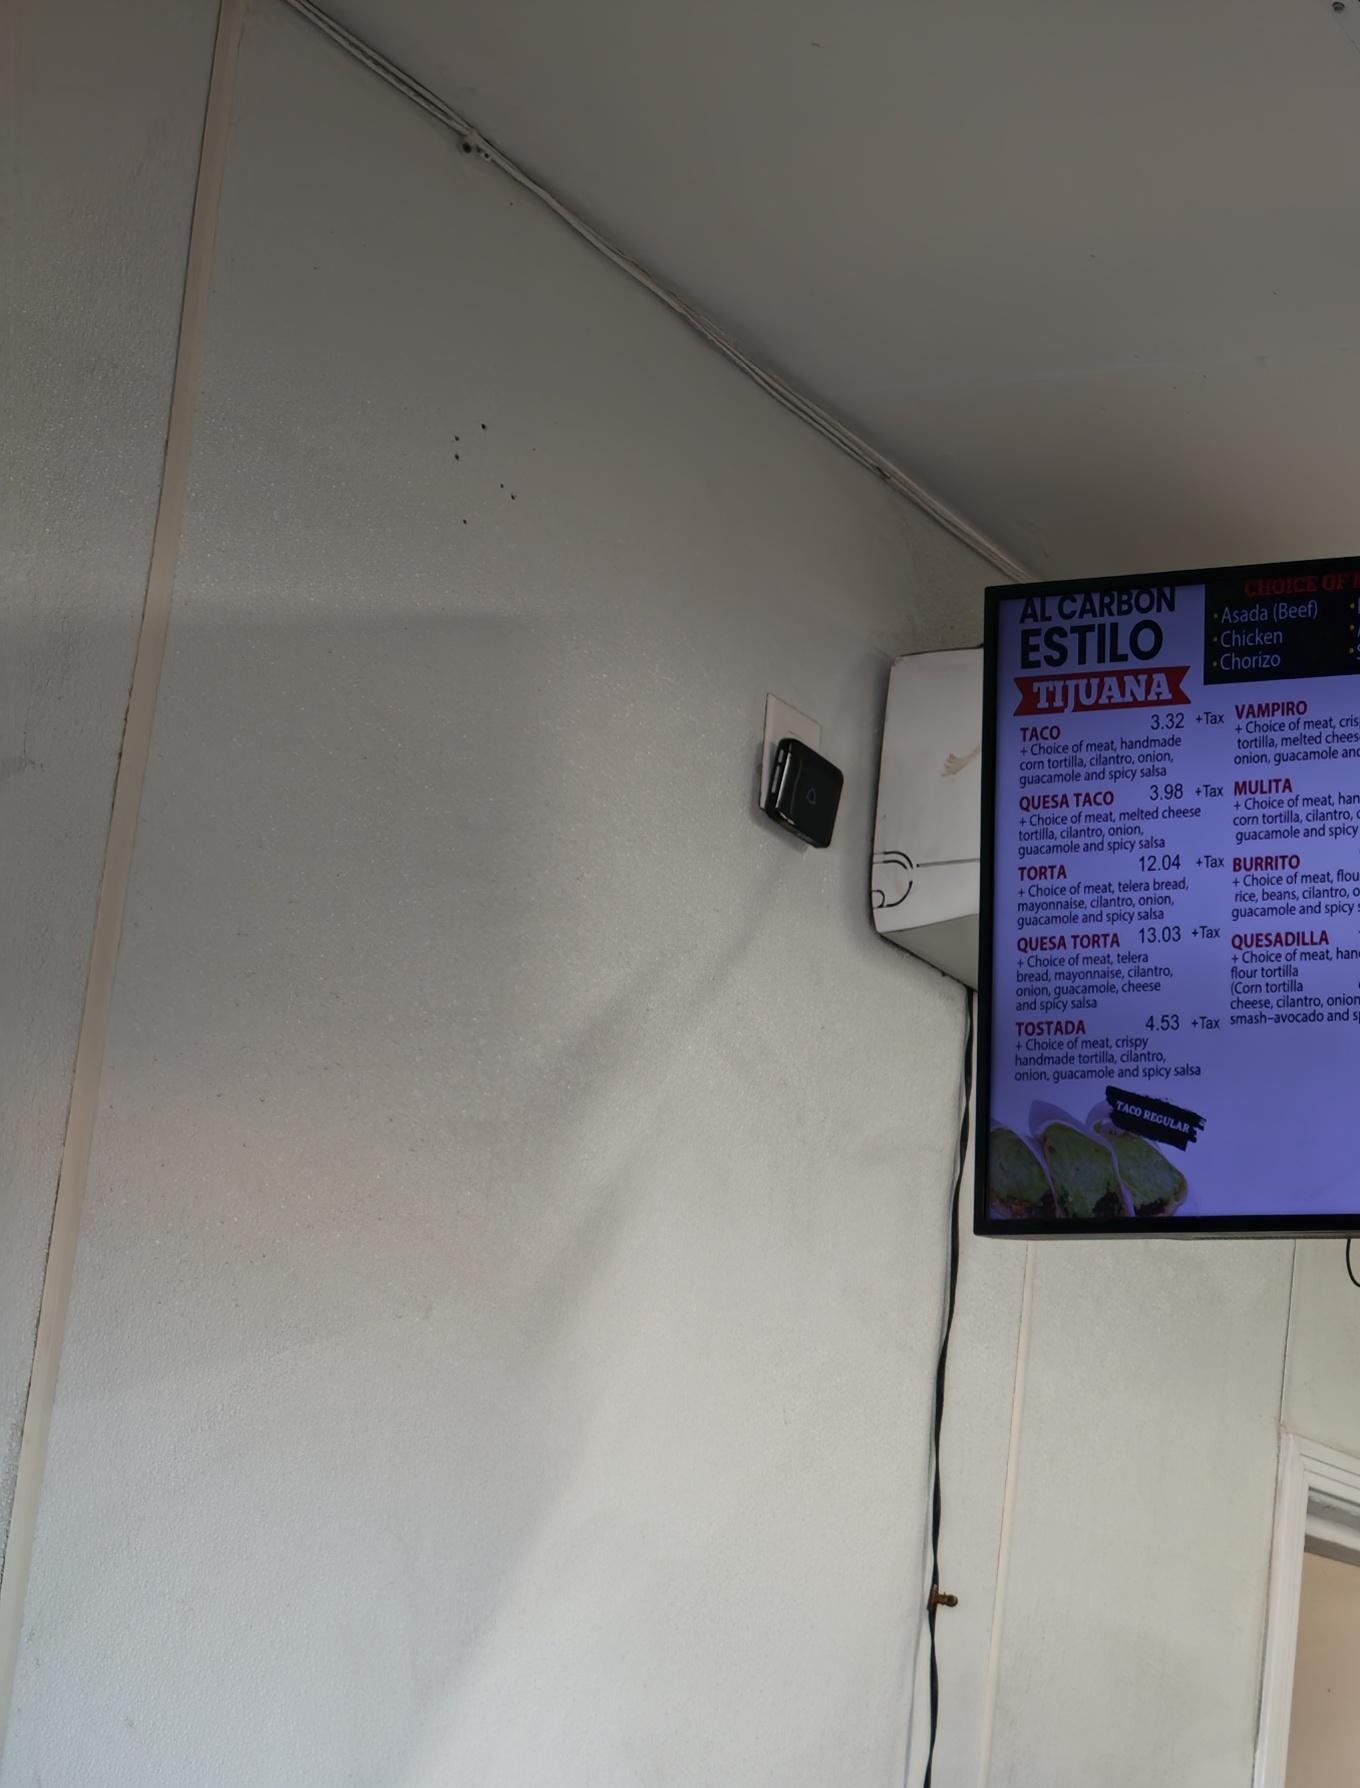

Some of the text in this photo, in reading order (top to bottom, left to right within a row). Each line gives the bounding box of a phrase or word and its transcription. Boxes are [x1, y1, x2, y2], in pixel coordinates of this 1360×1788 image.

[1244, 576, 1318, 597] CHOICE
[1322, 573, 1348, 591] OF
[1020, 586, 1176, 624] AL CARBON
[1221, 600, 1318, 624] Asada (Beef)
[1020, 619, 1163, 670] ESTILO
[1221, 628, 1283, 648] Chicken
[1220, 652, 1281, 670] Chorizo
[1032, 673, 1172, 716] TIJUANA
[1234, 700, 1307, 720] VAMPIRO
[1020, 711, 1224, 742] TACO 3.32 +Tax
[1019, 764, 1167, 789] guacamole and spicy salsa
[1234, 778, 1293, 796] MULITA
[1019, 783, 1183, 813] QUESA TACO 3.98
[1018, 854, 1181, 881] TORTA 12.04
[1233, 854, 1300, 872] BURRITO
[1017, 926, 1181, 954] QUESA TORTA 13.03
[1231, 930, 1329, 951] QUESADILLA
[1015, 1014, 1220, 1037] TOSTADA 4.53 +Tax
[1014, 1049, 1166, 1067] handmade tortilla, cilantro,
[1116, 1100, 1190, 1133] TACO REGULAR
